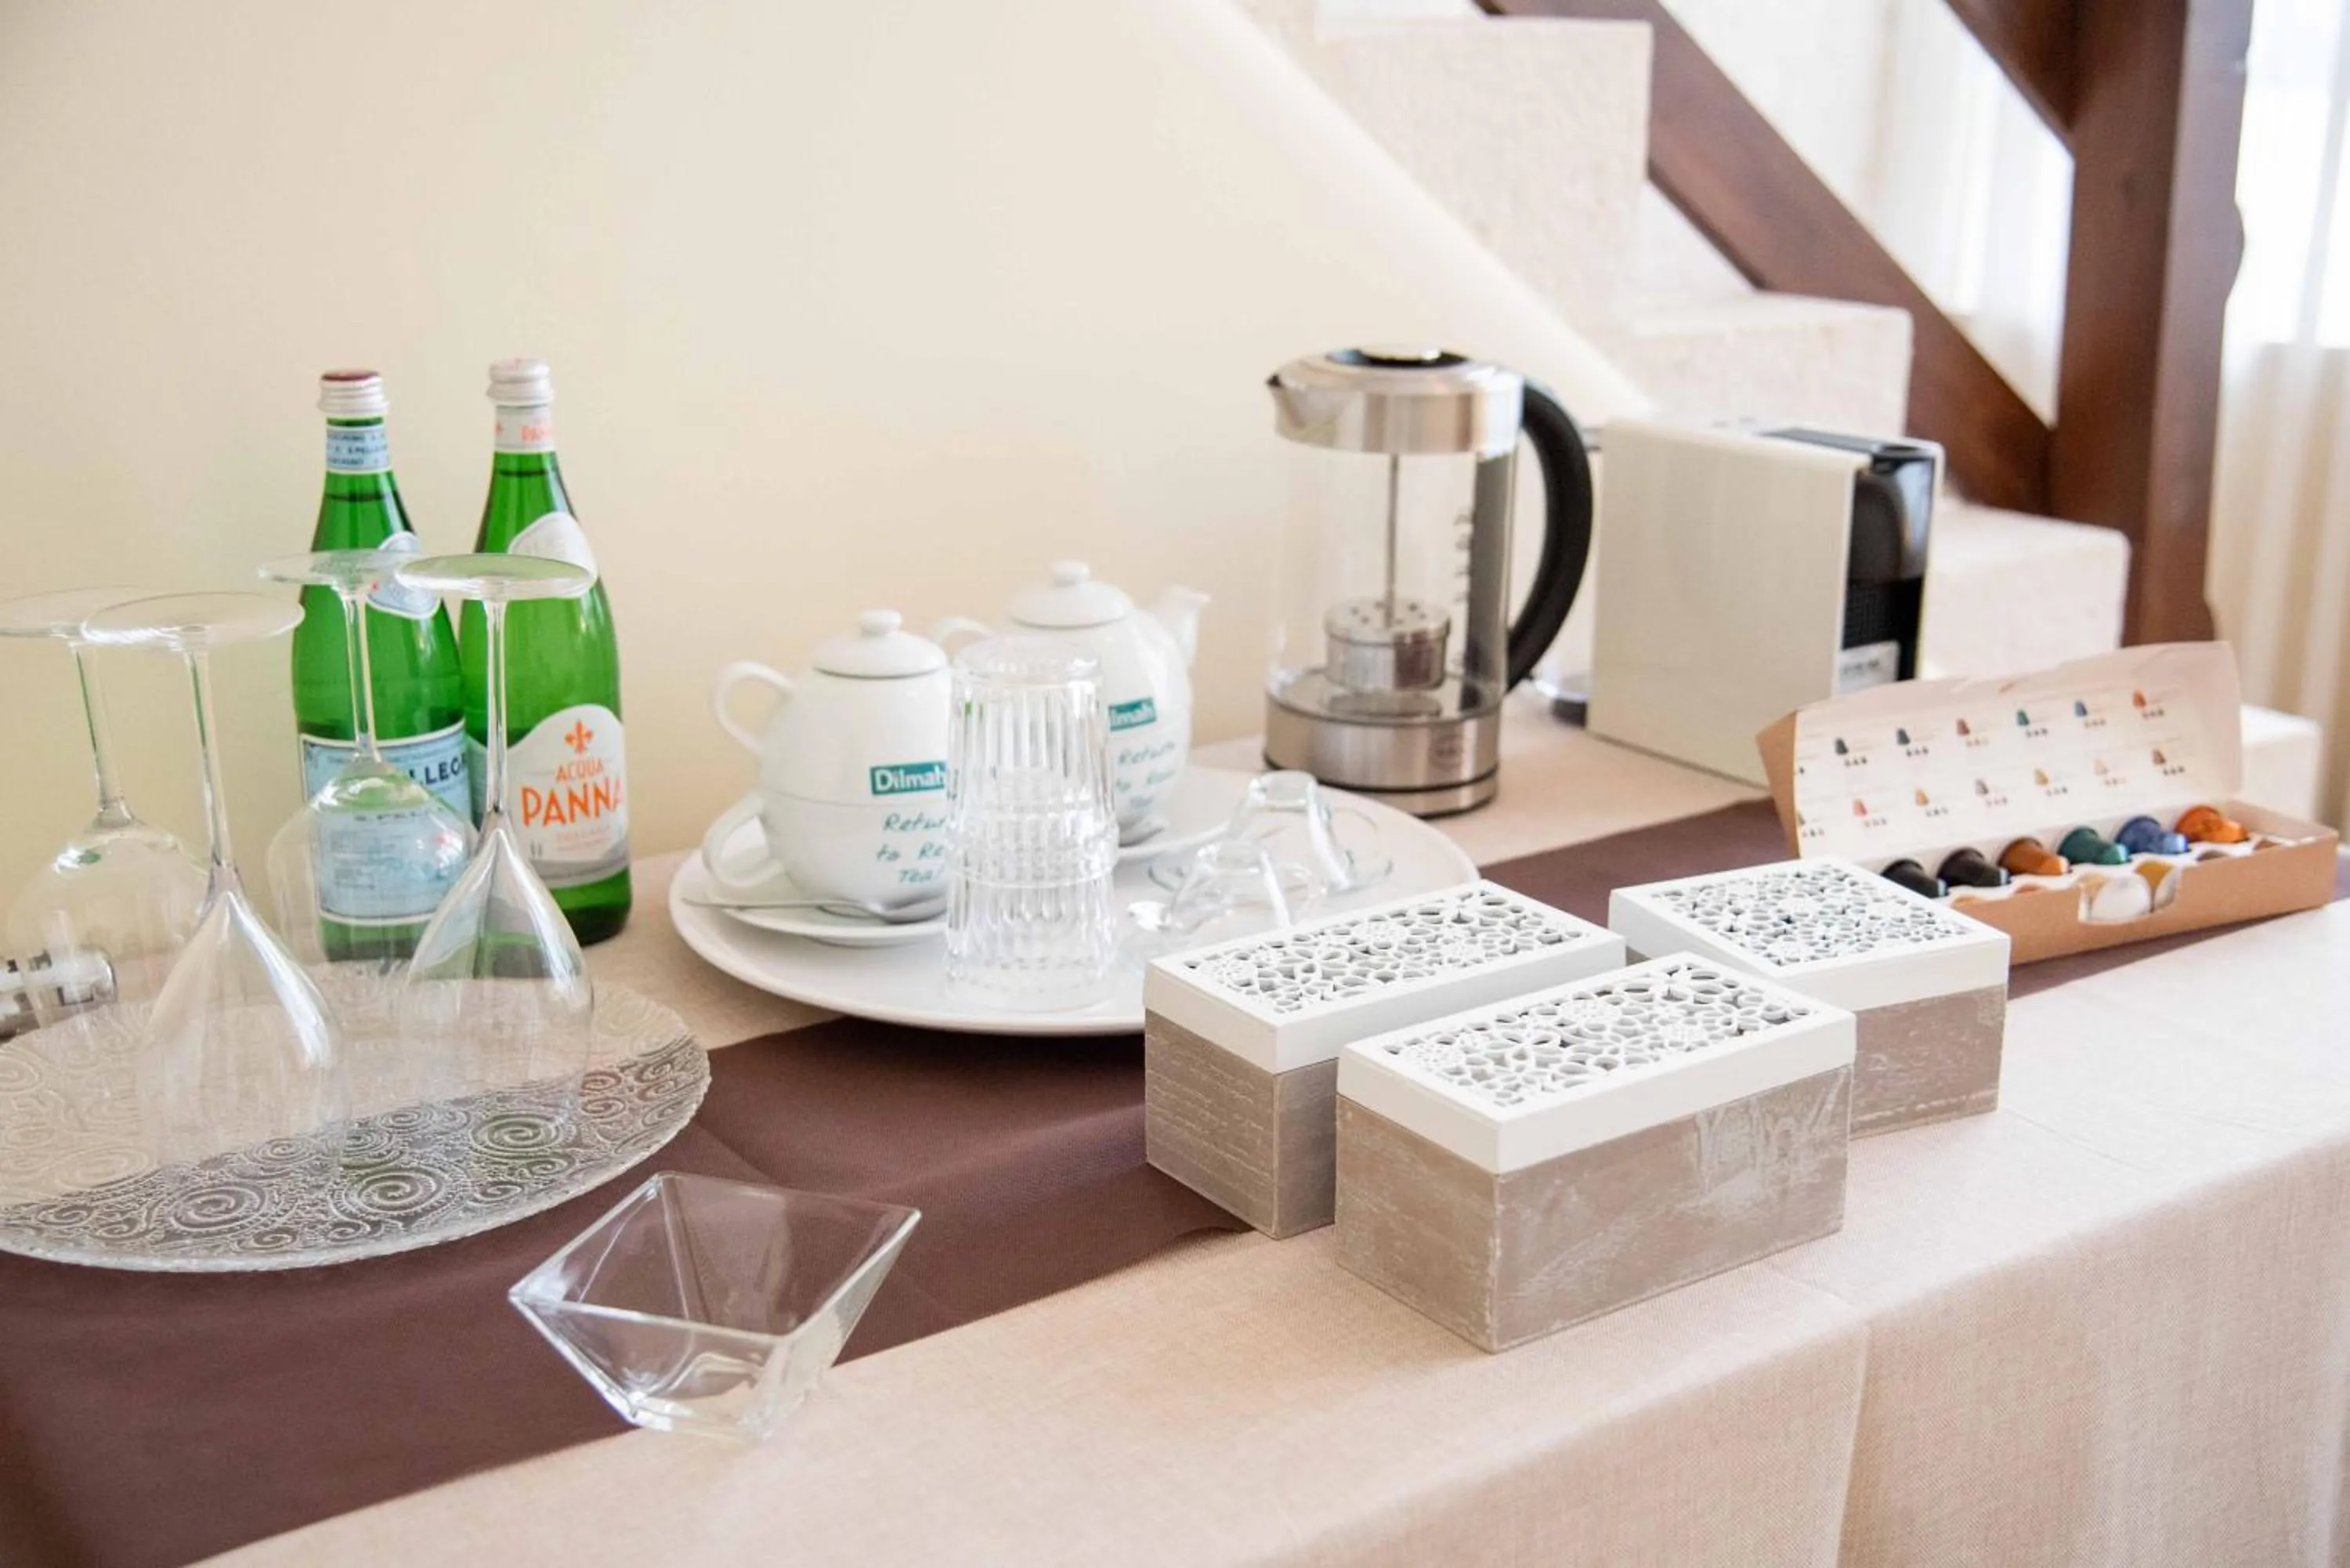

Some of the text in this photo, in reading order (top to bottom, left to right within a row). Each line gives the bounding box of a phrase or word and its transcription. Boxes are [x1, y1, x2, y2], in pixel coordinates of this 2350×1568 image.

[555, 758, 603, 782] ACQUA
[875, 764, 945, 791] Dilmah
[877, 841, 945, 862] to Re
